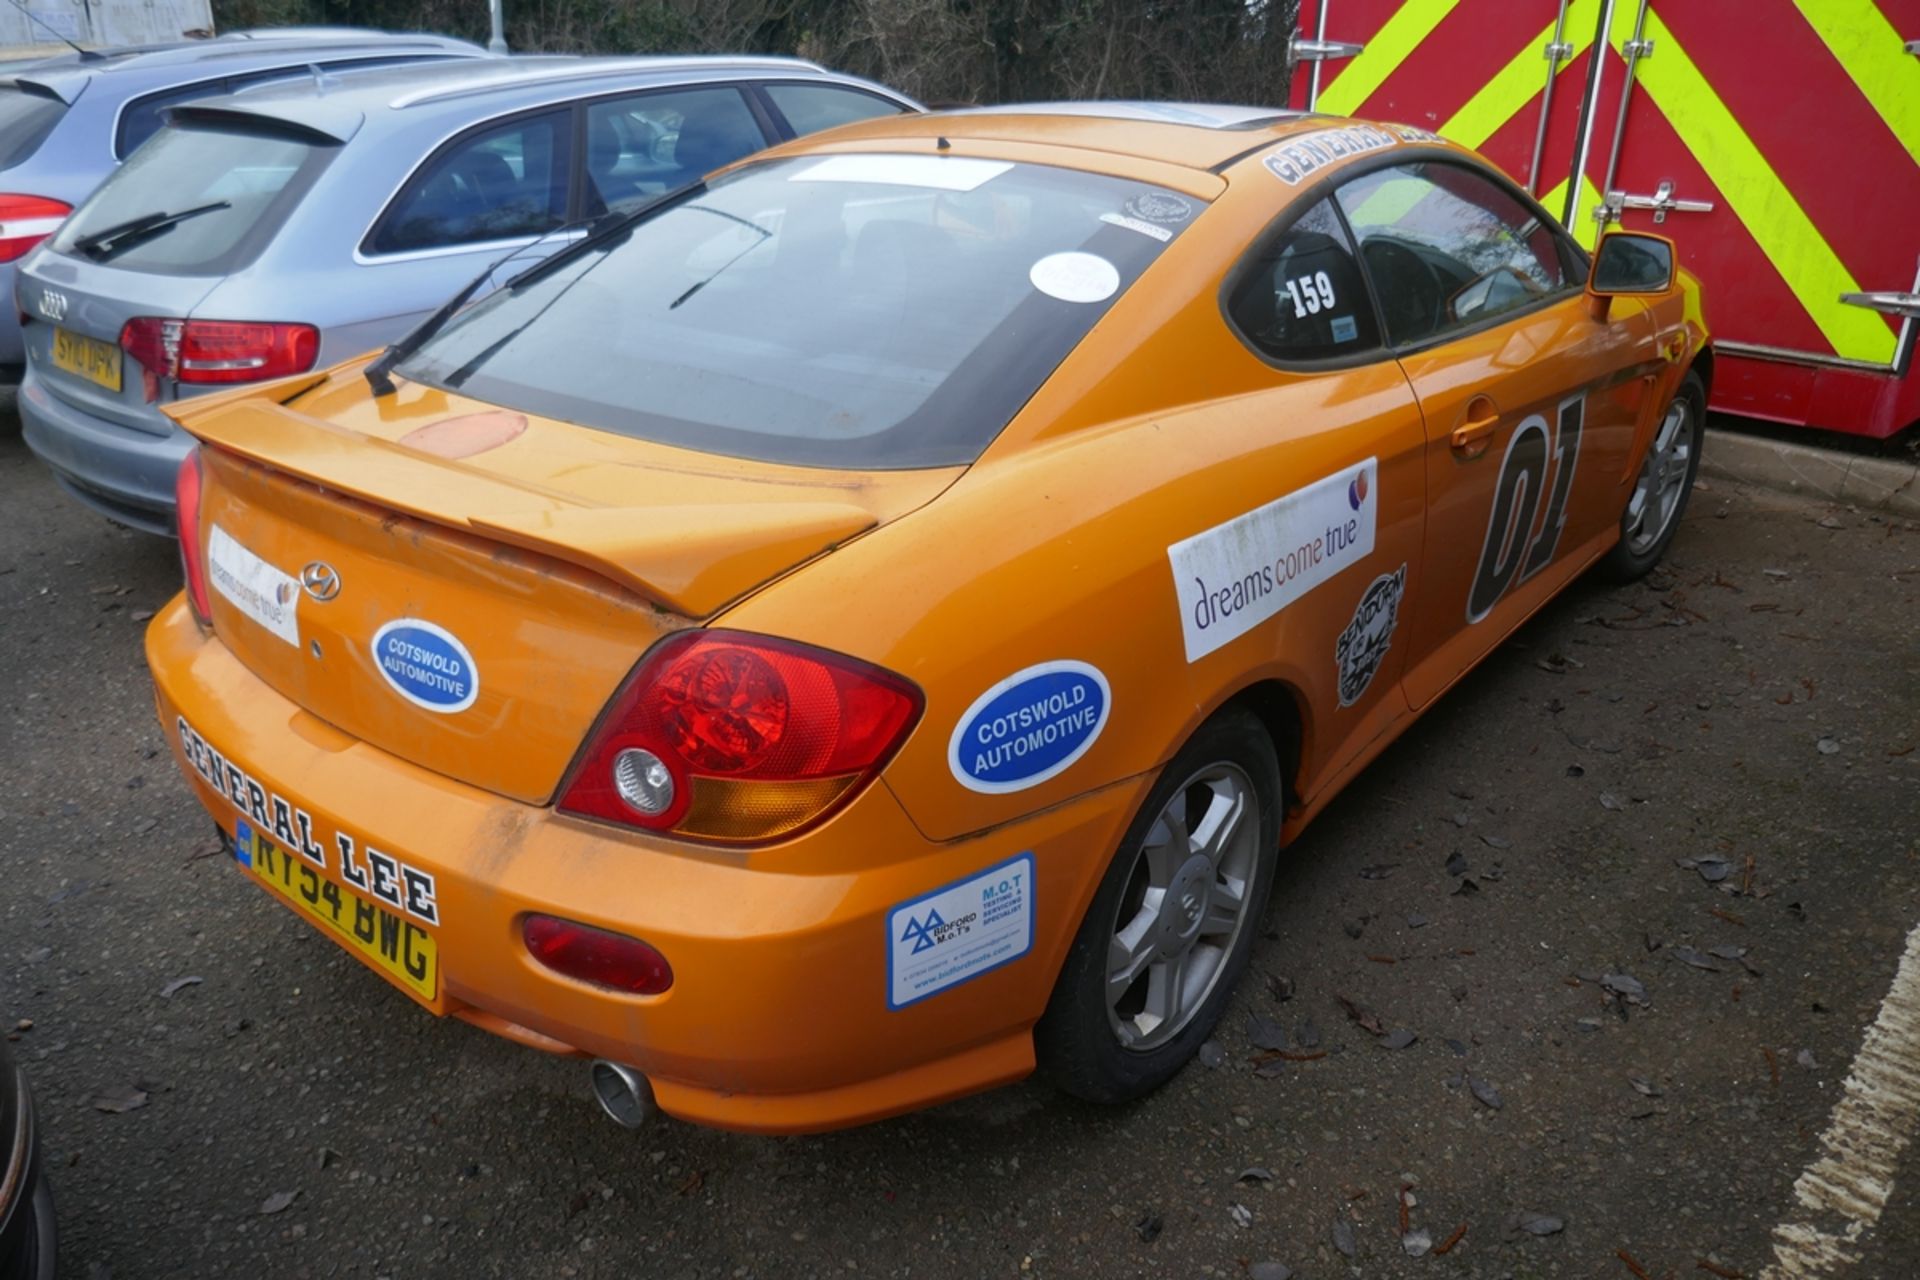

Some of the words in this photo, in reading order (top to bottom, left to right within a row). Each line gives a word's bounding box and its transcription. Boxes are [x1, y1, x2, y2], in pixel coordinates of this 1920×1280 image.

[1263, 125, 1397, 185] GENERAL
[1286, 271, 1336, 319] 159
[1467, 394, 1585, 624] 01
[1195, 565, 1274, 630] dreams
[1275, 537, 1323, 586] come
[1325, 519, 1357, 557] true
[384, 656, 465, 698] AUTOMOTIVE
[388, 638, 460, 676] COTSWOLD
[974, 705, 1096, 775] AUTOMOTIVE
[977, 684, 1086, 744] COTSWOLD
[177, 716, 326, 868] GENERAL
[336, 831, 440, 927] LEE
[982, 873, 1022, 901] M.O.T
[983, 898, 1023, 918] SERVICING
[353, 896, 428, 982] BWG
[933, 912, 977, 937] BIDFORD
[983, 904, 1023, 926] SPECIALIST
